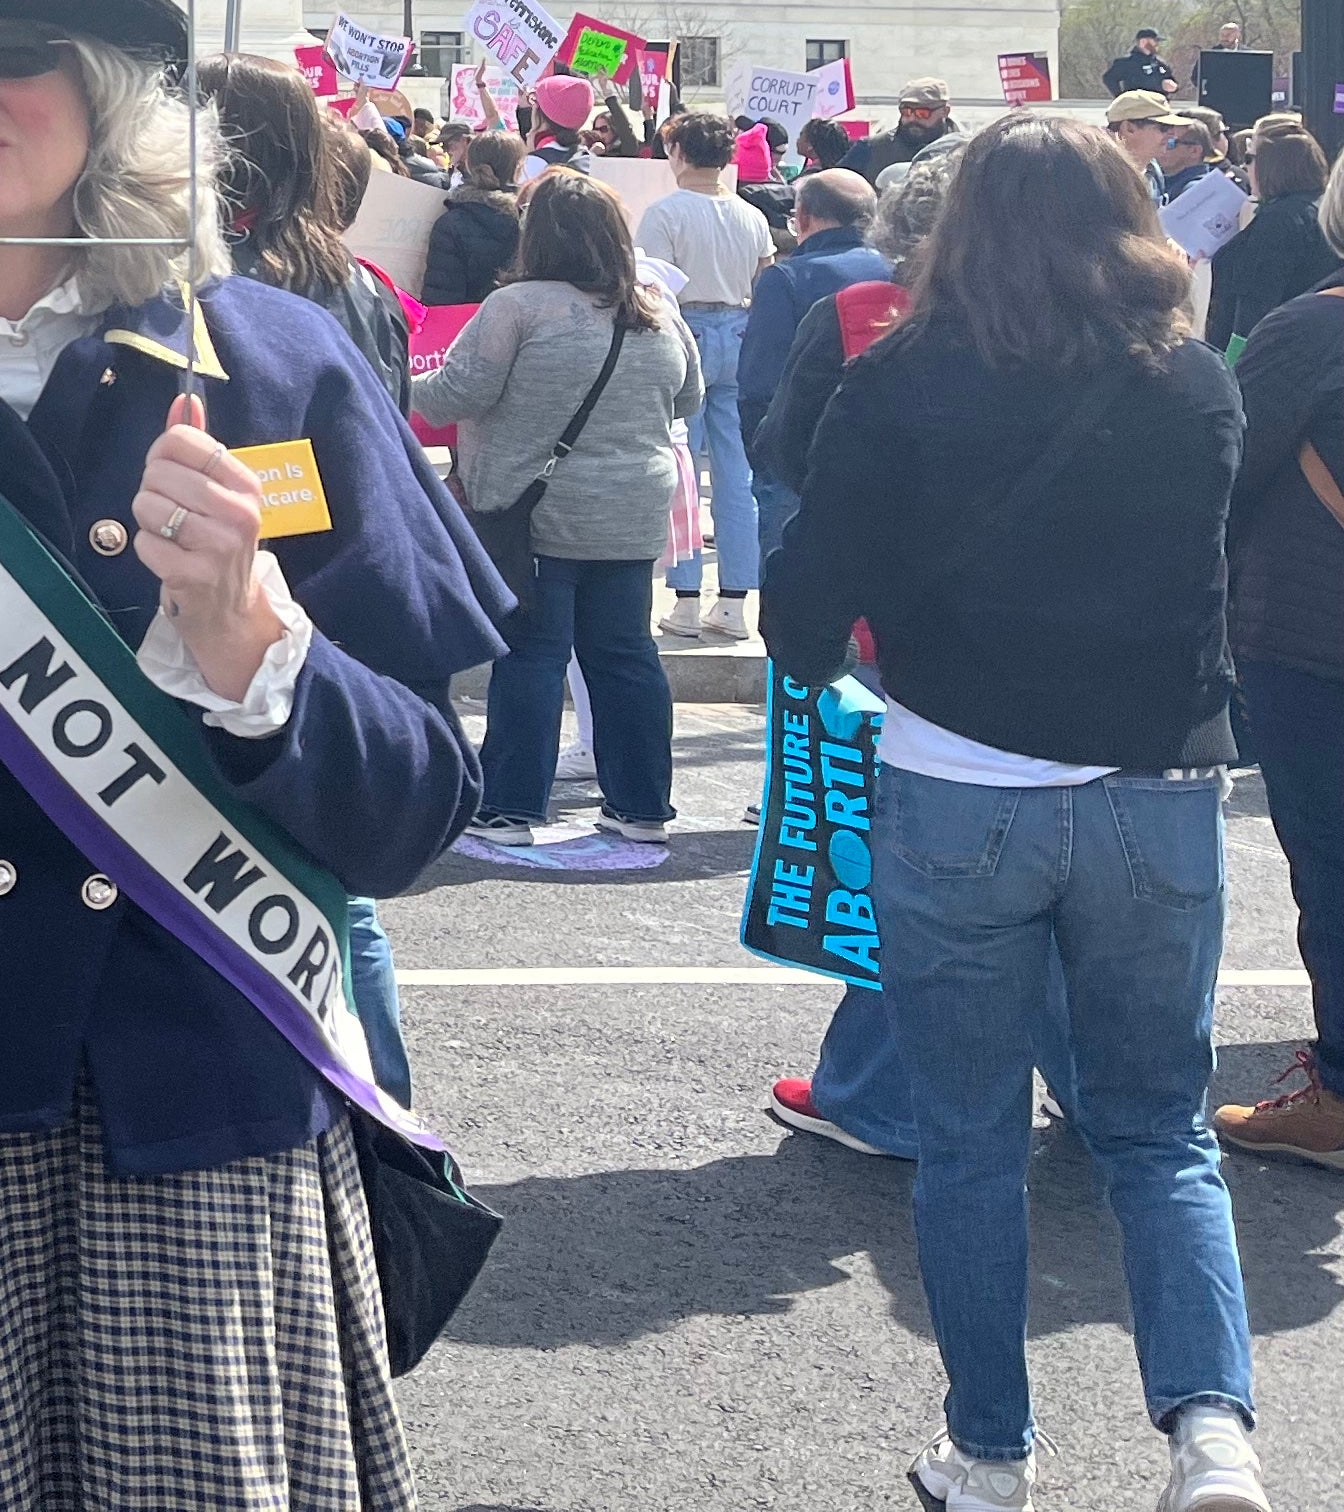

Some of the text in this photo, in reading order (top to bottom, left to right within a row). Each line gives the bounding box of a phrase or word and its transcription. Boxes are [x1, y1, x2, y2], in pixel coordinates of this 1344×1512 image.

[339, 15, 405, 53] WE WON'T STOP
[474, 10, 541, 84] SAFE
[748, 95, 803, 116] COURT
[751, 76, 817, 100] CORRUPT
[284, 462, 304, 479] Is
[779, 710, 818, 851] FUTURE
[767, 859, 815, 929] THE
